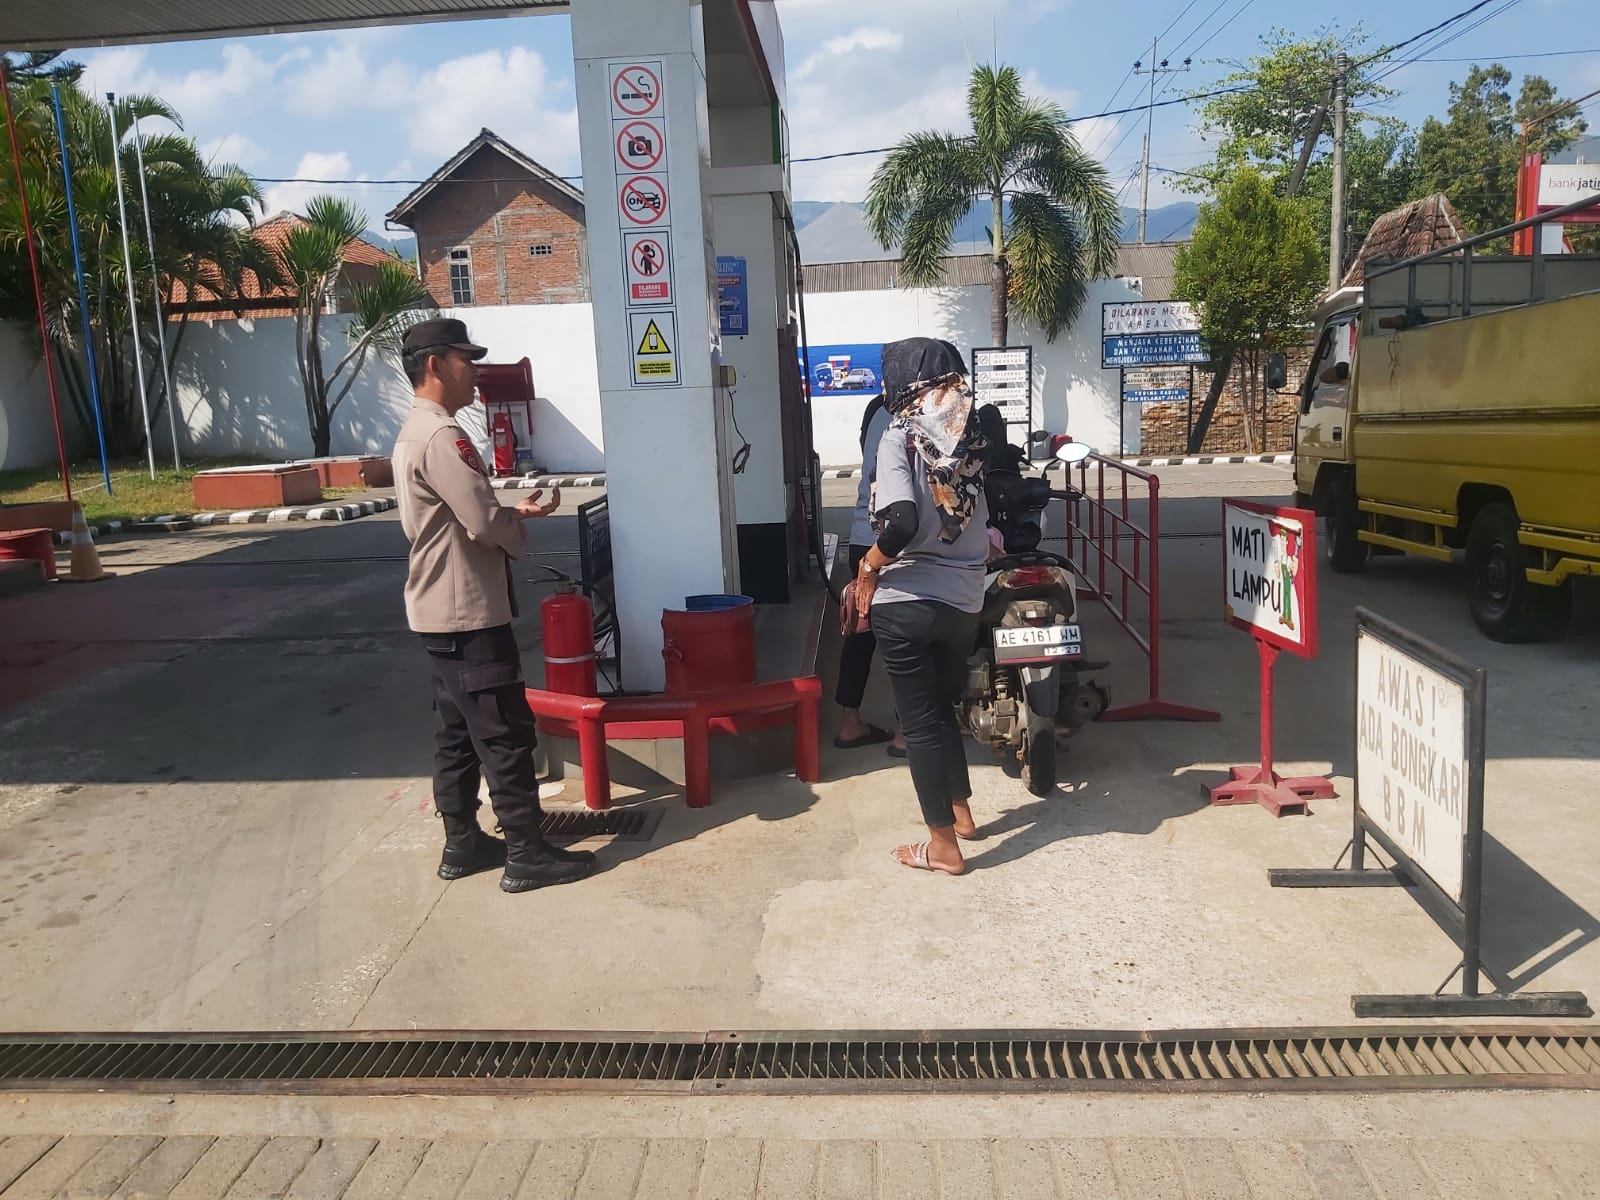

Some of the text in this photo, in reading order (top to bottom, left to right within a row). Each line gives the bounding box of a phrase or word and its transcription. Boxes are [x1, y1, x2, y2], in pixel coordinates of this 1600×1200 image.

[1549, 177, 1576, 188] bank
[1111, 307, 1157, 318] DILARANG
[1108, 321, 1120, 330] DI
[1127, 320, 1168, 329] AREAL
[1117, 338, 1151, 347] MENJAGA
[1113, 347, 1128, 356] DAN
[1132, 346, 1173, 355] KEINDAHAN
[1232, 525, 1265, 564] MATI
[1232, 568, 1282, 614] LAMPU
[1001, 632, 1017, 645] AE
[1022, 630, 1052, 643] 4161
[1359, 700, 1461, 821] ADA BONGKAR
